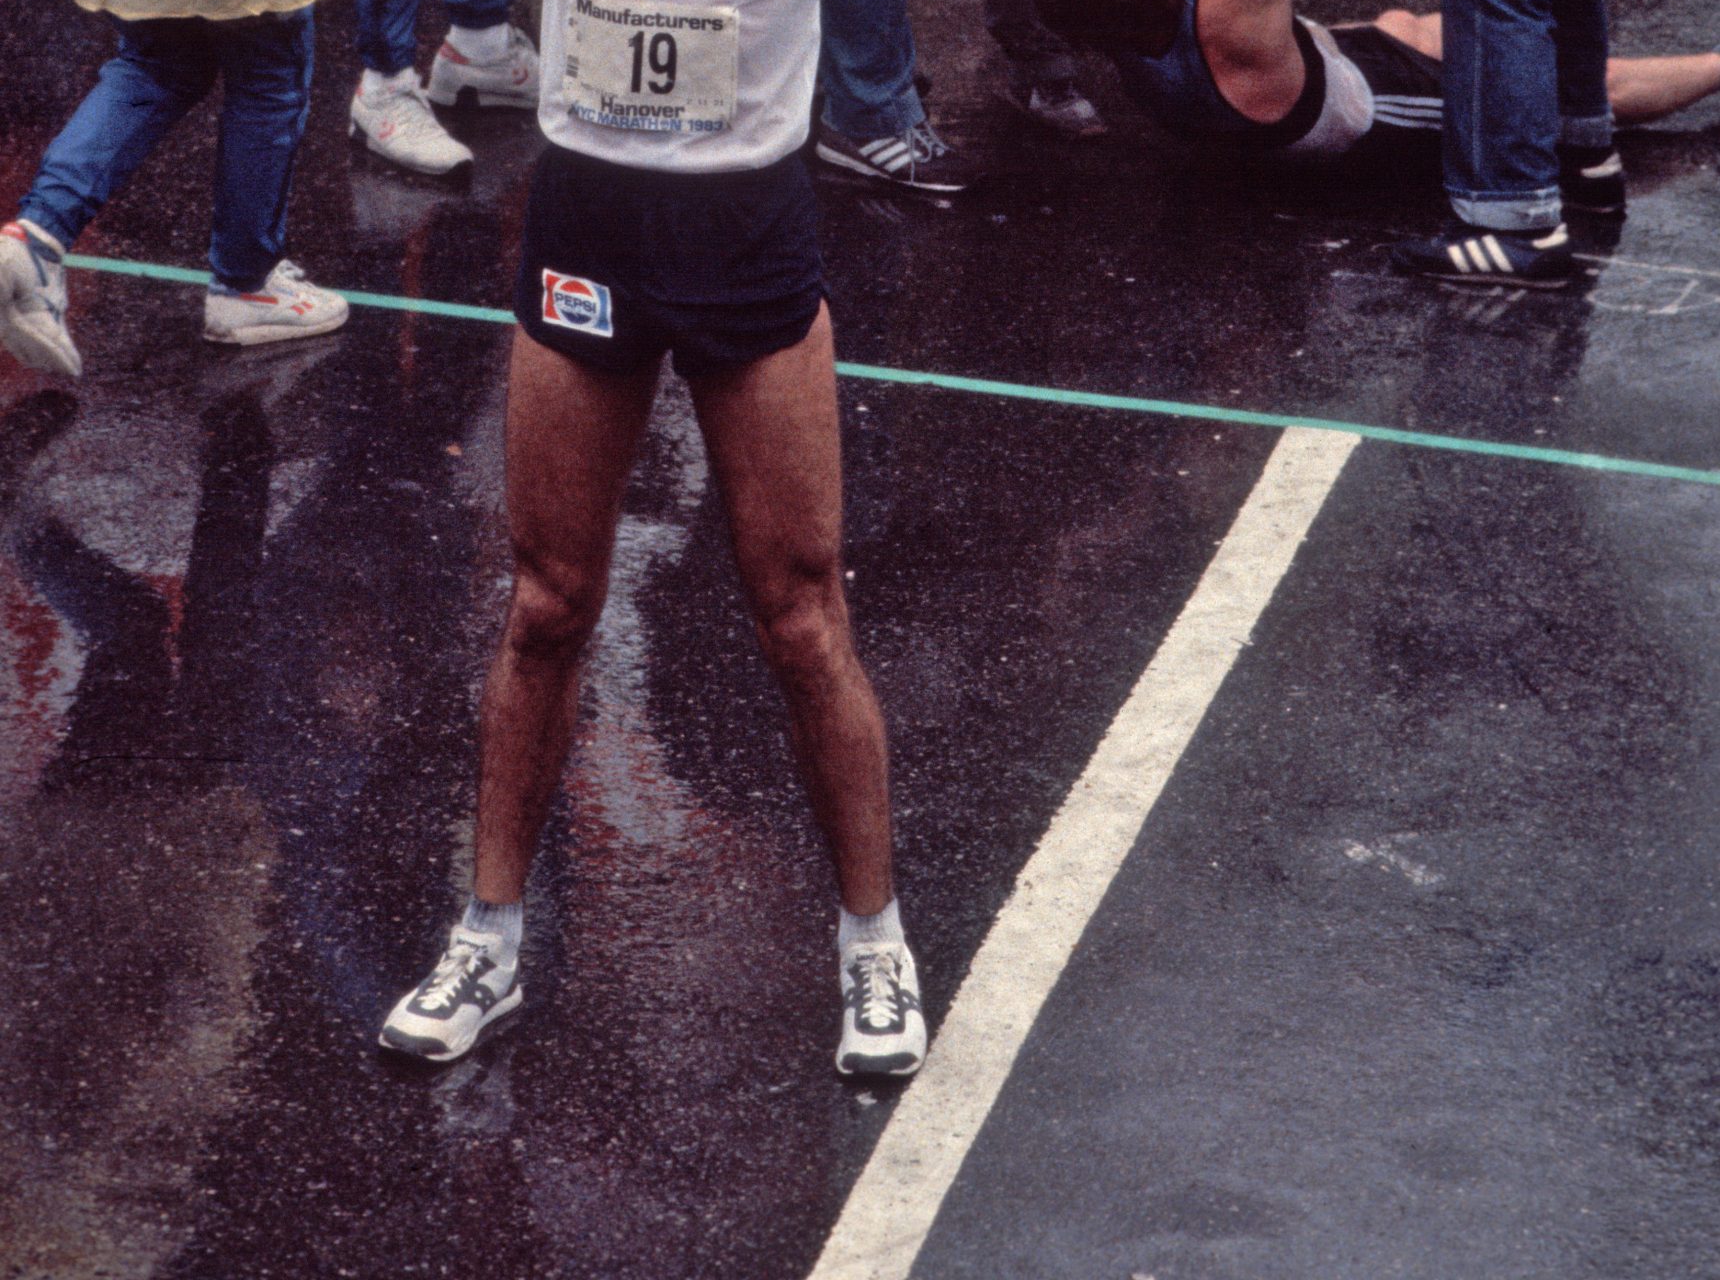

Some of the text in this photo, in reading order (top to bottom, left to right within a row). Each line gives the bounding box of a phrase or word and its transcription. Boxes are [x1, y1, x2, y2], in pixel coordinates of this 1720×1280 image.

[627, 30, 678, 95] 19
[600, 94, 685, 119] Hanover
[554, 292, 598, 314] PEPSI
